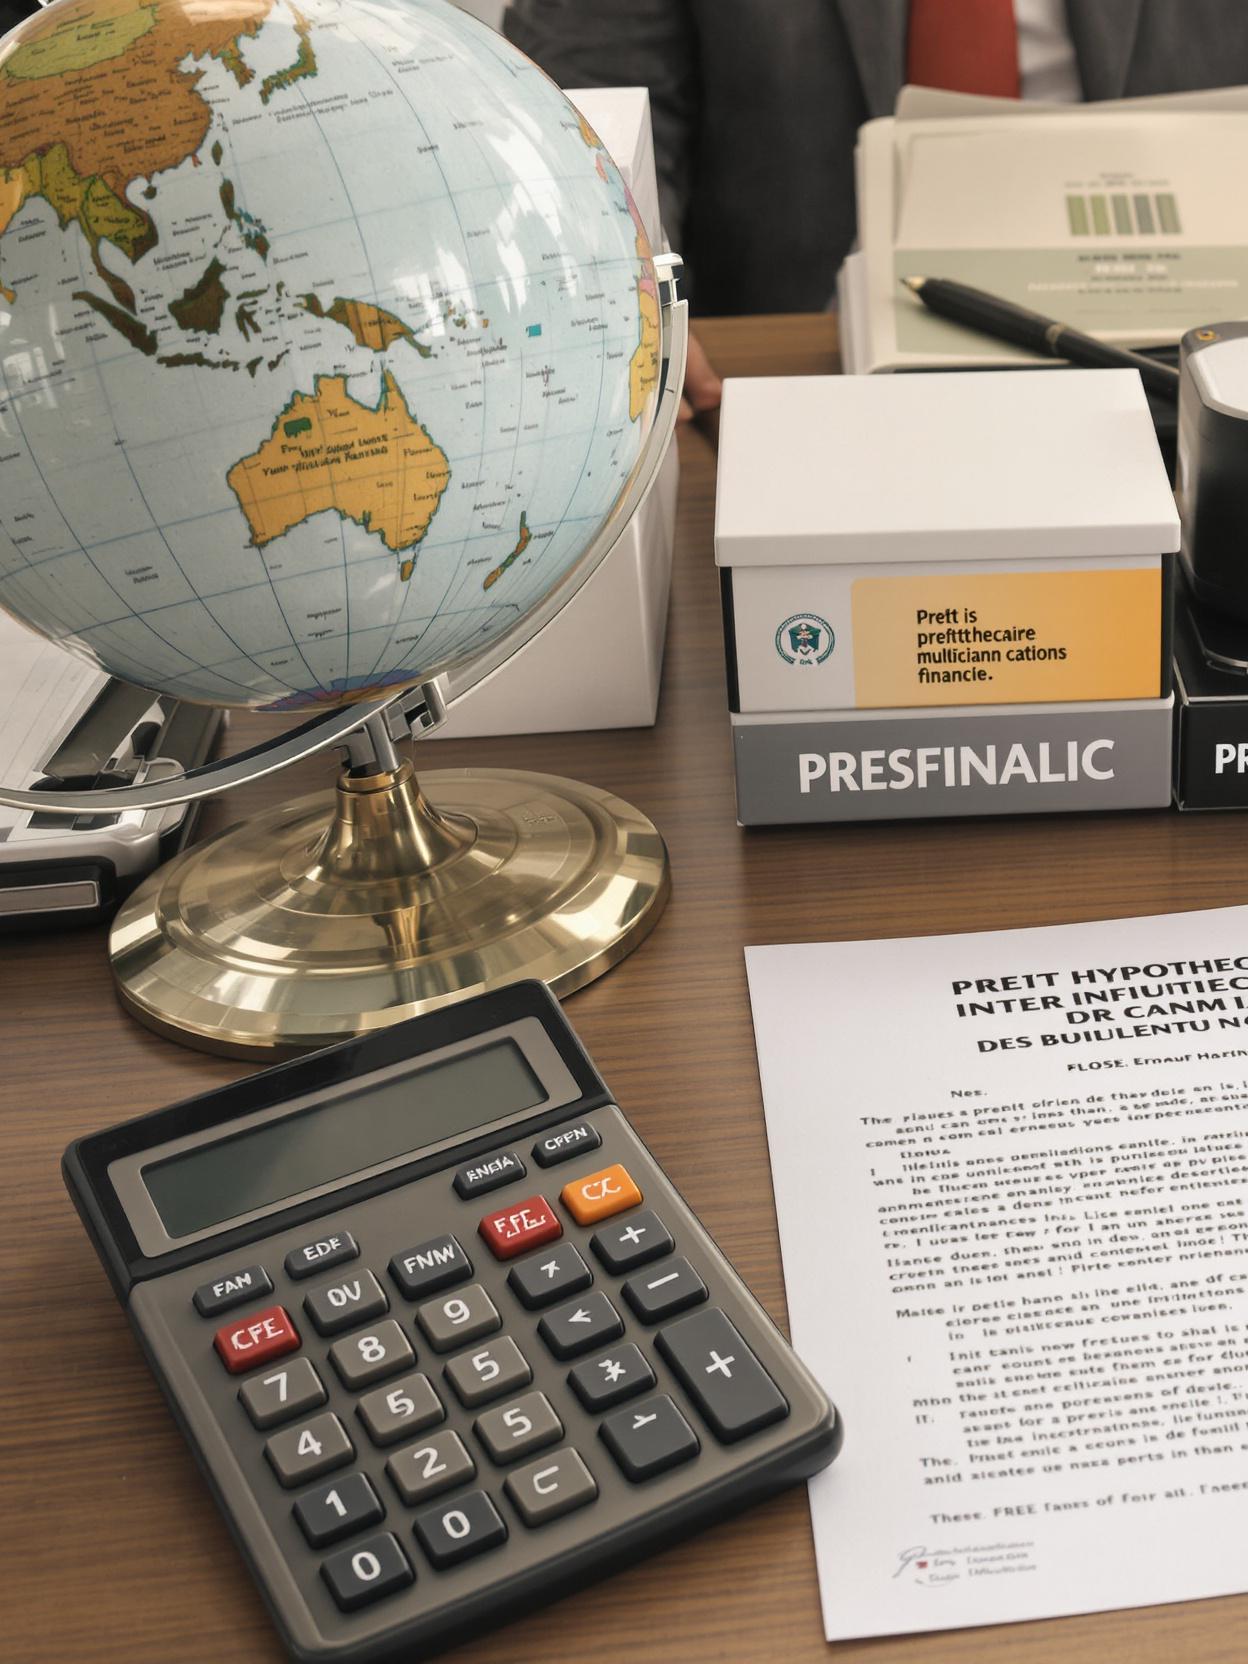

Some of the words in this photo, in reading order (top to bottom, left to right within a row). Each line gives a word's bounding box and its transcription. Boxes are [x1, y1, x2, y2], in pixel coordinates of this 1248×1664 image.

[964, 608, 977, 624] is
[1006, 645, 1067, 662] cations
[799, 739, 1115, 793] PRESFINALIC
[955, 994, 1066, 1019] INTER
[1064, 1007, 1117, 1026] DR
[975, 1035, 1034, 1054] DES
[442, 1299, 471, 1324] 9
[357, 1336, 386, 1363] 8
[472, 1351, 500, 1382] 5
[264, 1371, 288, 1402] 7
[502, 1407, 532, 1438] 5
[297, 1430, 323, 1457] 4
[413, 1447, 447, 1479] 2
[324, 1489, 348, 1517] 1
